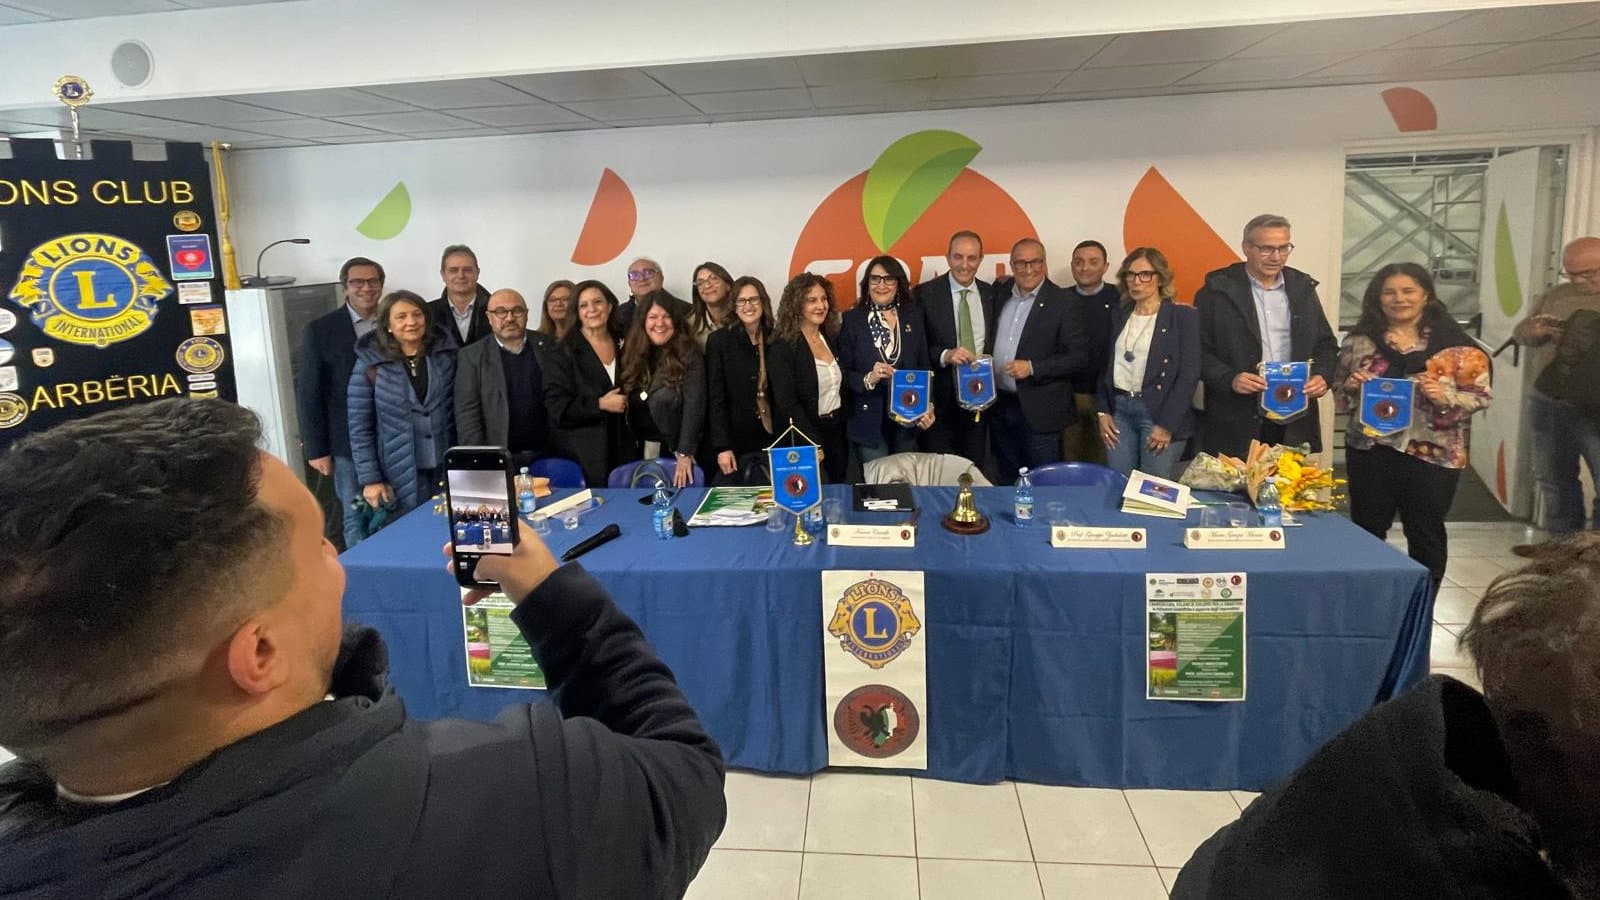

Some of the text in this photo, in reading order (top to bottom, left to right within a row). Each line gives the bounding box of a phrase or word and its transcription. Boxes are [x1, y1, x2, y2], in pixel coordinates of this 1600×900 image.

[92, 180, 194, 205] CLUB
[40, 238, 135, 263] LIONS
[72, 270, 117, 310] L
[53, 315, 146, 338] INTERNATIONAL
[31, 373, 182, 411] ARBËRIA
[850, 583, 898, 601] LIONS
[863, 607, 889, 639] L
